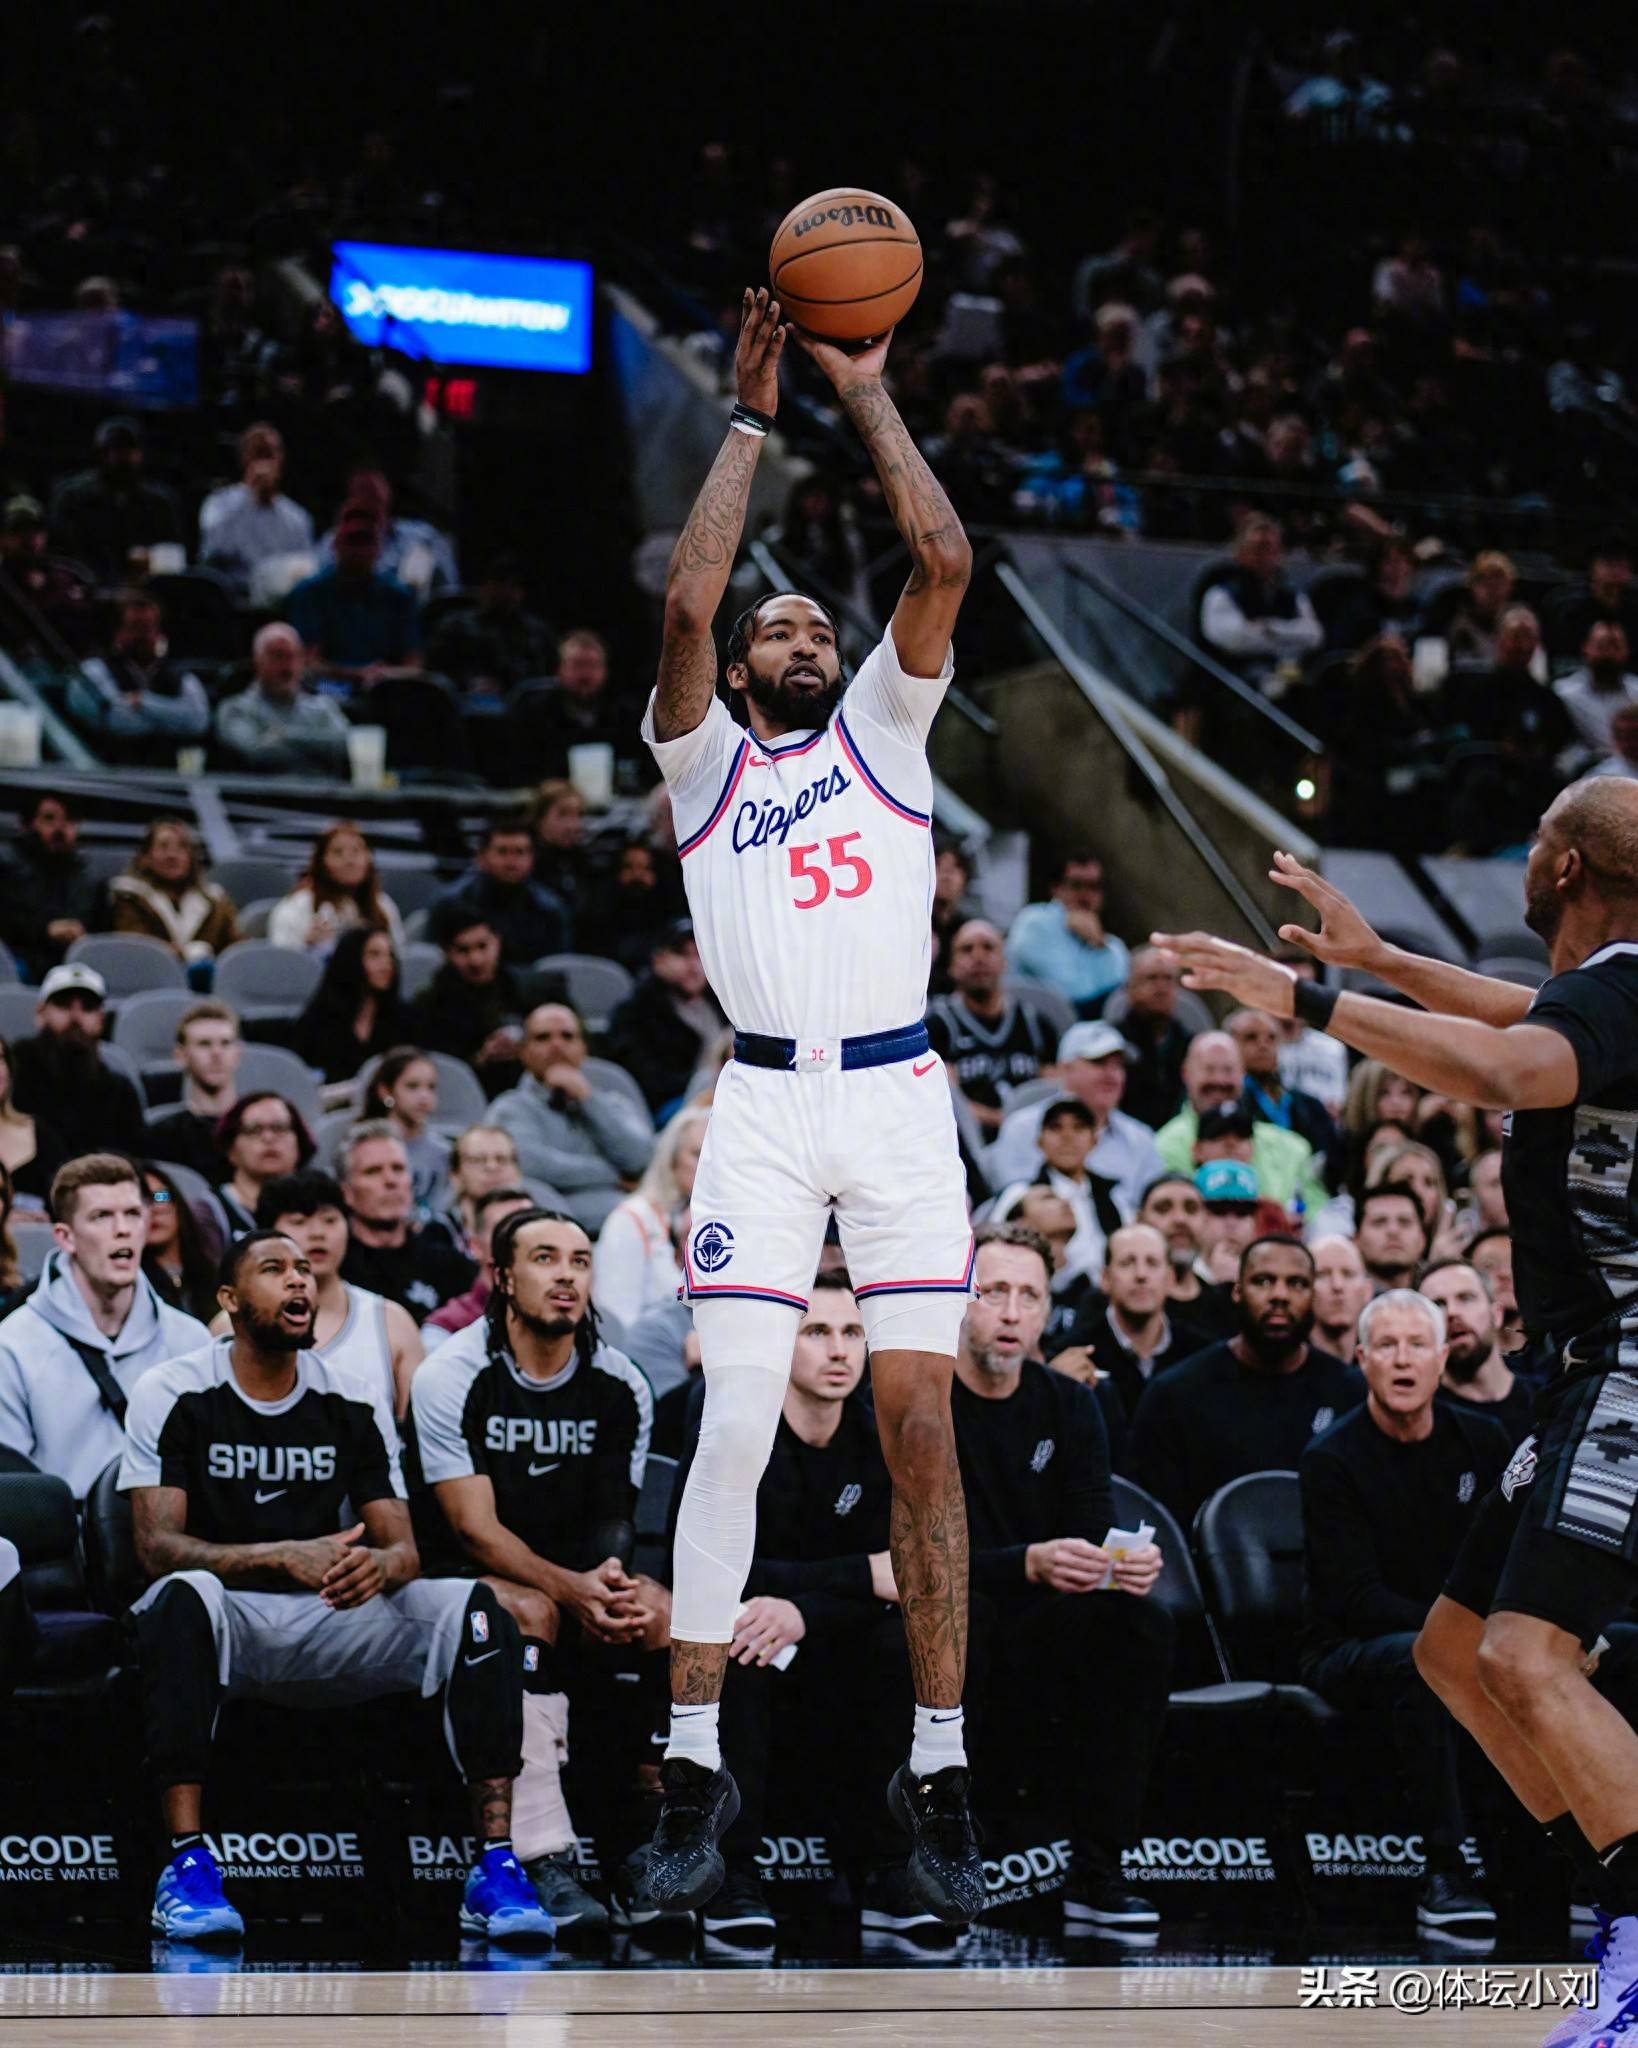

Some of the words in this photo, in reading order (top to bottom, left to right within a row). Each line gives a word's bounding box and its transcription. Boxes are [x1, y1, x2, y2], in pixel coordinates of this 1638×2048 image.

[793, 205, 896, 238] Wilson
[788, 831, 873, 909] 55
[485, 1415, 597, 1455] SPURS
[208, 1443, 336, 1481] SPURS
[0, 1834, 118, 1865] CODE
[59, 1867, 120, 1880] WATER
[305, 1865, 365, 1878] WATER
[413, 1868, 467, 1880] PERFO
[1220, 1867, 1277, 1881] WATER
